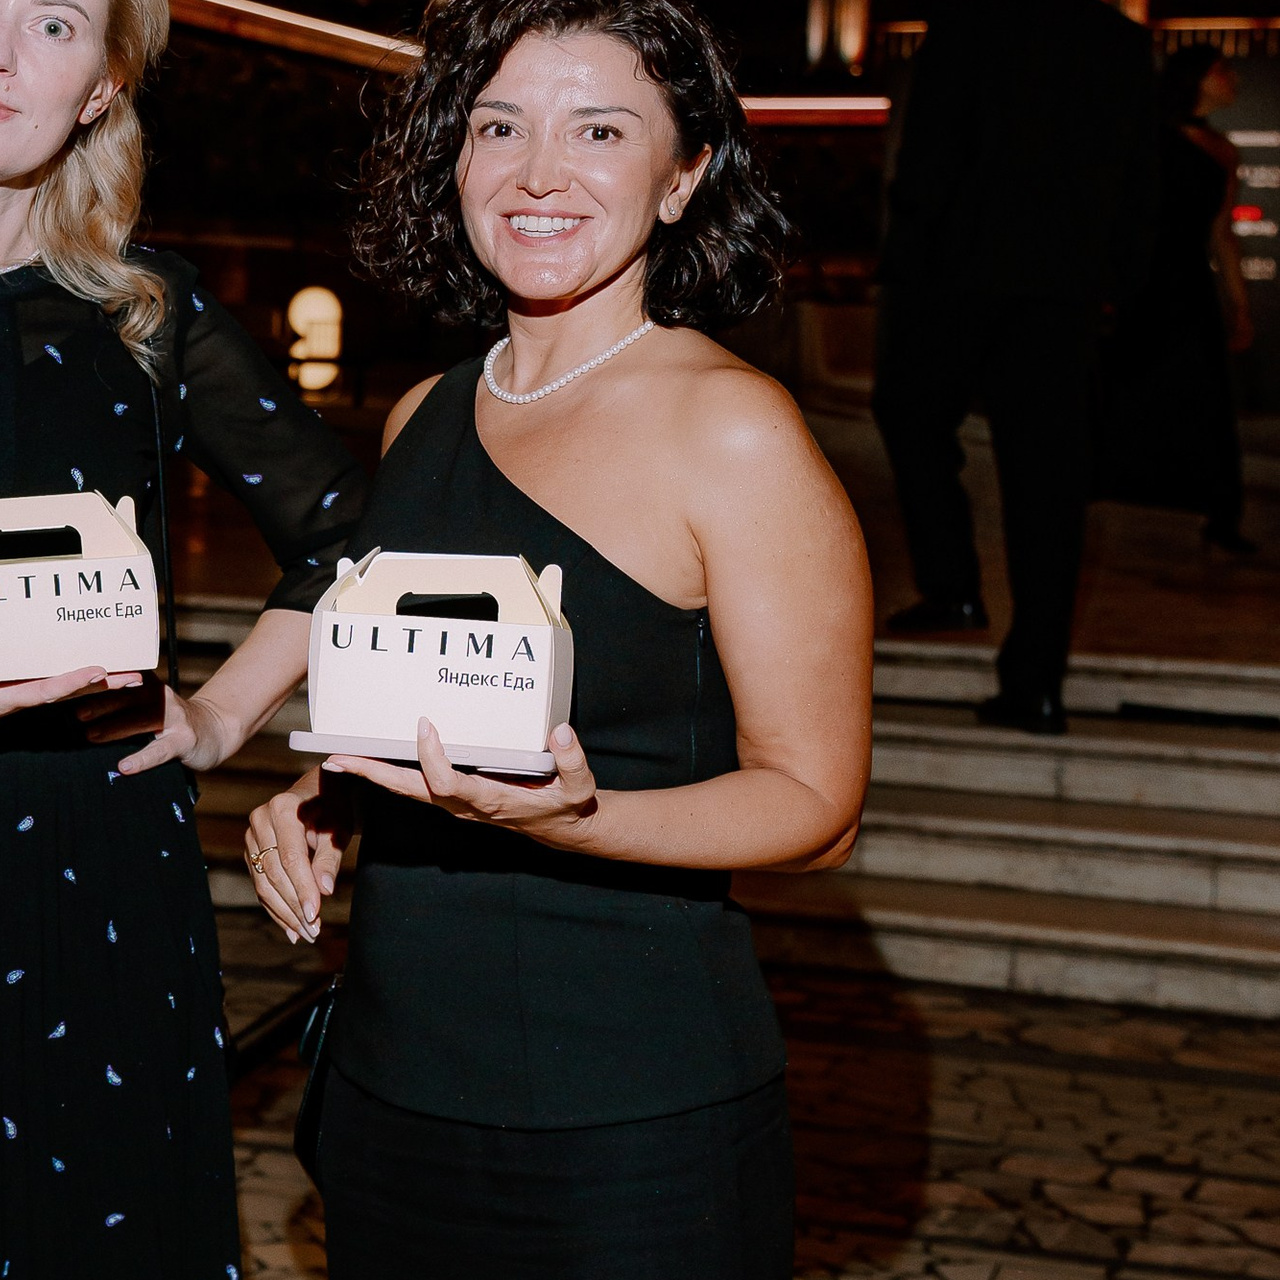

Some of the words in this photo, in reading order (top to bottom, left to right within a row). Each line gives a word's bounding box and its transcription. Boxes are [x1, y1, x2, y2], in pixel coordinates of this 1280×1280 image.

[55, 606, 112, 623] Яндекс
[115, 602, 143, 619] Еда
[331, 623, 536, 662] ULTIMA
[437, 667, 499, 688] Яндекс
[503, 672, 535, 691] Еда
